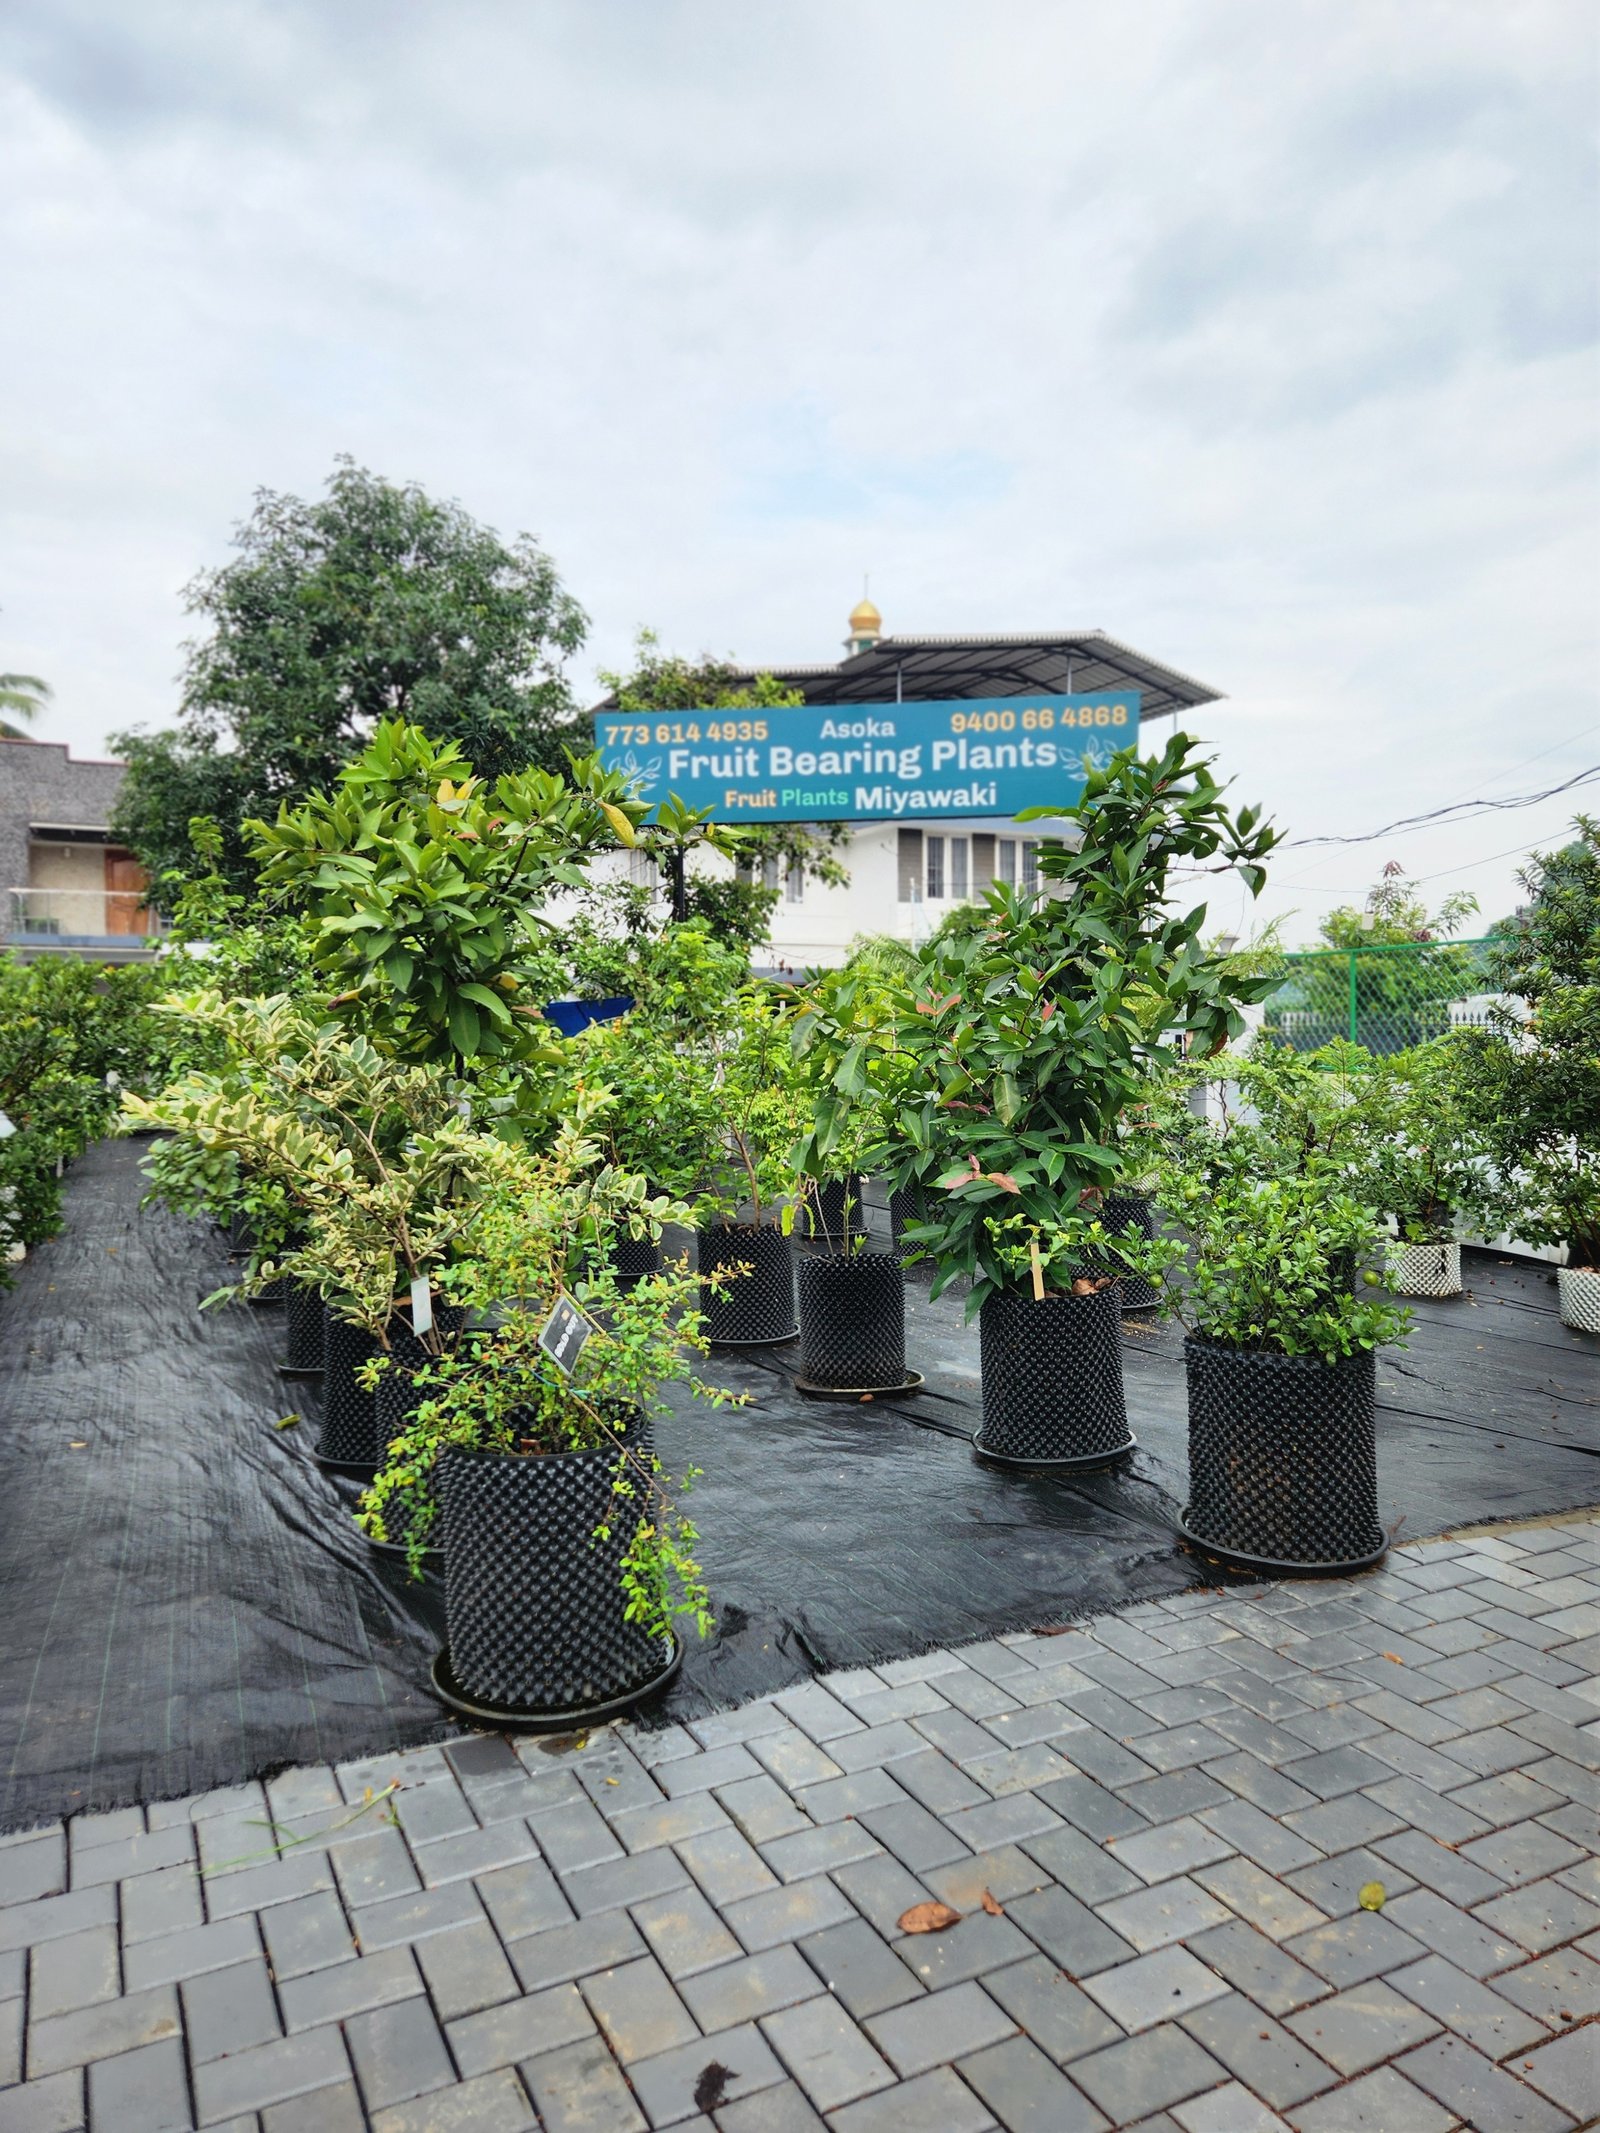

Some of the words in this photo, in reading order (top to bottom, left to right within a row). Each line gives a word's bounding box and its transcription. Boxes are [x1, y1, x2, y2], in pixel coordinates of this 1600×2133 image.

[605, 724, 650, 746] 773
[655, 722, 700, 744] 614
[706, 720, 768, 742] 4935
[820, 717, 896, 739] Asoka
[951, 710, 1015, 733] 9400
[1022, 708, 1054, 730] 66
[1061, 705, 1127, 728] 4868
[669, 747, 759, 779] Fruit
[770, 742, 922, 780] Bearing
[932, 737, 1057, 771] Plants
[725, 790, 777, 808] Fruit
[781, 788, 848, 807] Plants
[855, 782, 997, 814] Miyawaki
[554, 1333, 569, 1358] SOLD
[565, 1314, 579, 1336] OUT
